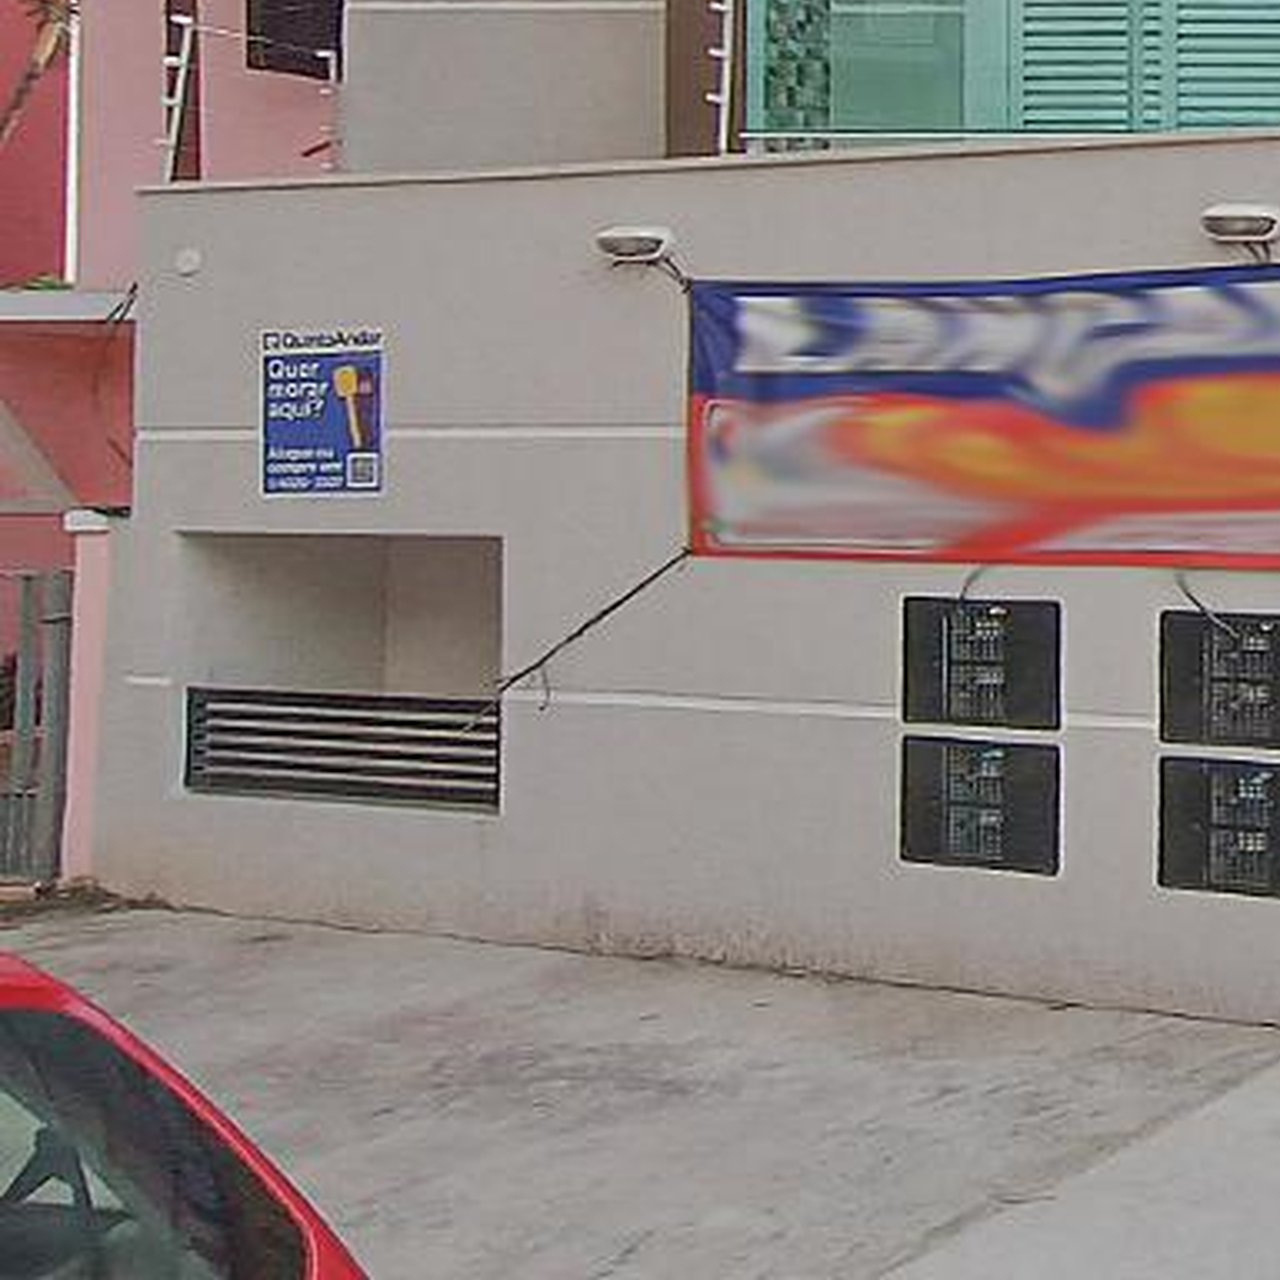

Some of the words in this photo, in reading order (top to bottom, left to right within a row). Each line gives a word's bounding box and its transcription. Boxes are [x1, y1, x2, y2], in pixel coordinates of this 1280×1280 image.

[283, 331, 381, 348] QuintoAndar
[268, 359, 320, 380] Quer
[267, 382, 328, 399] morar
[268, 400, 324, 420] aqui?
